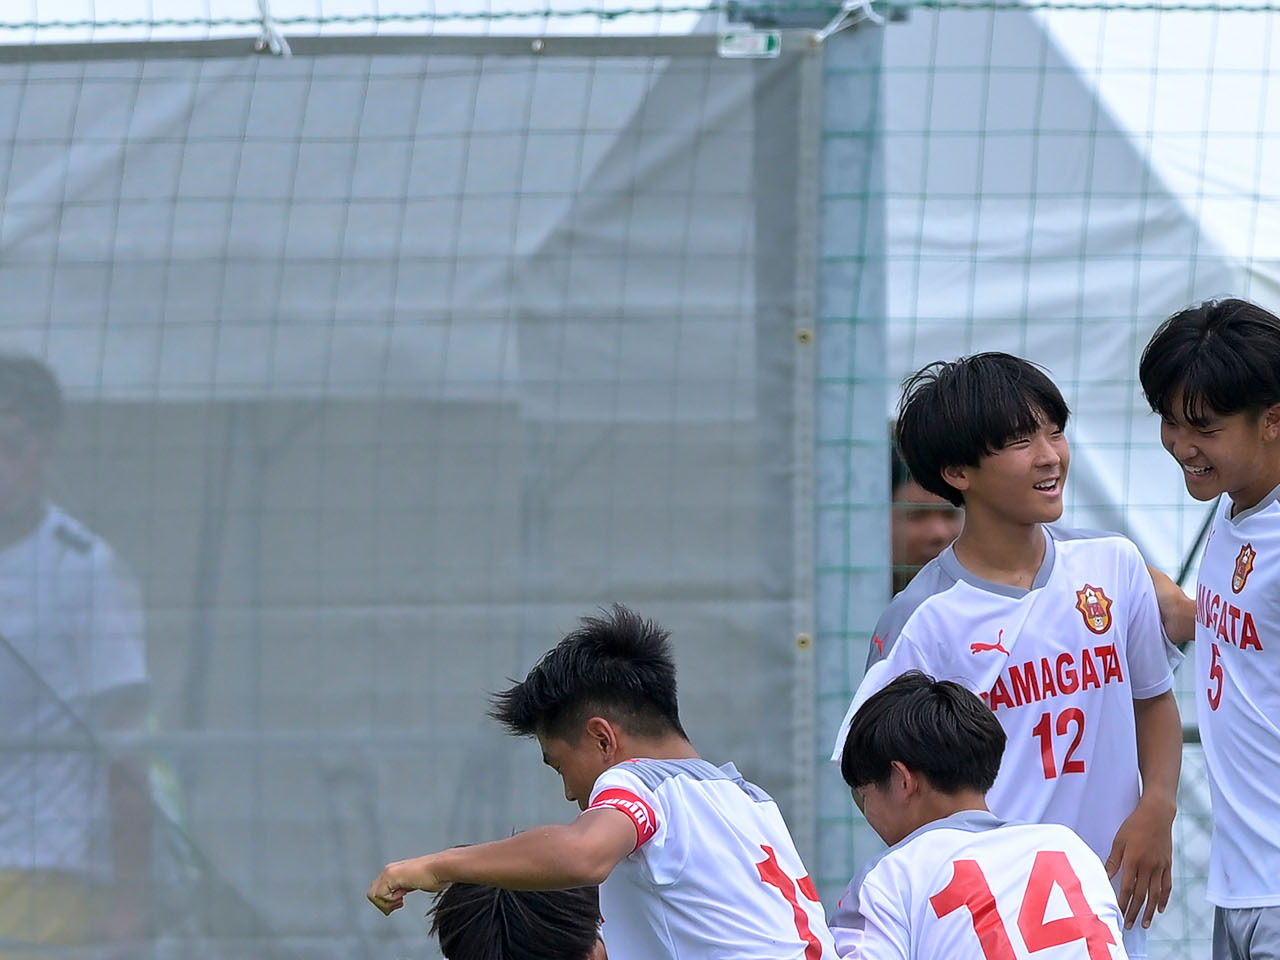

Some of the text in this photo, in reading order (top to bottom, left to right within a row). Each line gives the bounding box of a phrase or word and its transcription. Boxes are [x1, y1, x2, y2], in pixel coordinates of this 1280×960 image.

[980, 643, 1124, 711] AMAGATA
[1207, 642, 1224, 711] 5
[1032, 707, 1086, 780] 12
